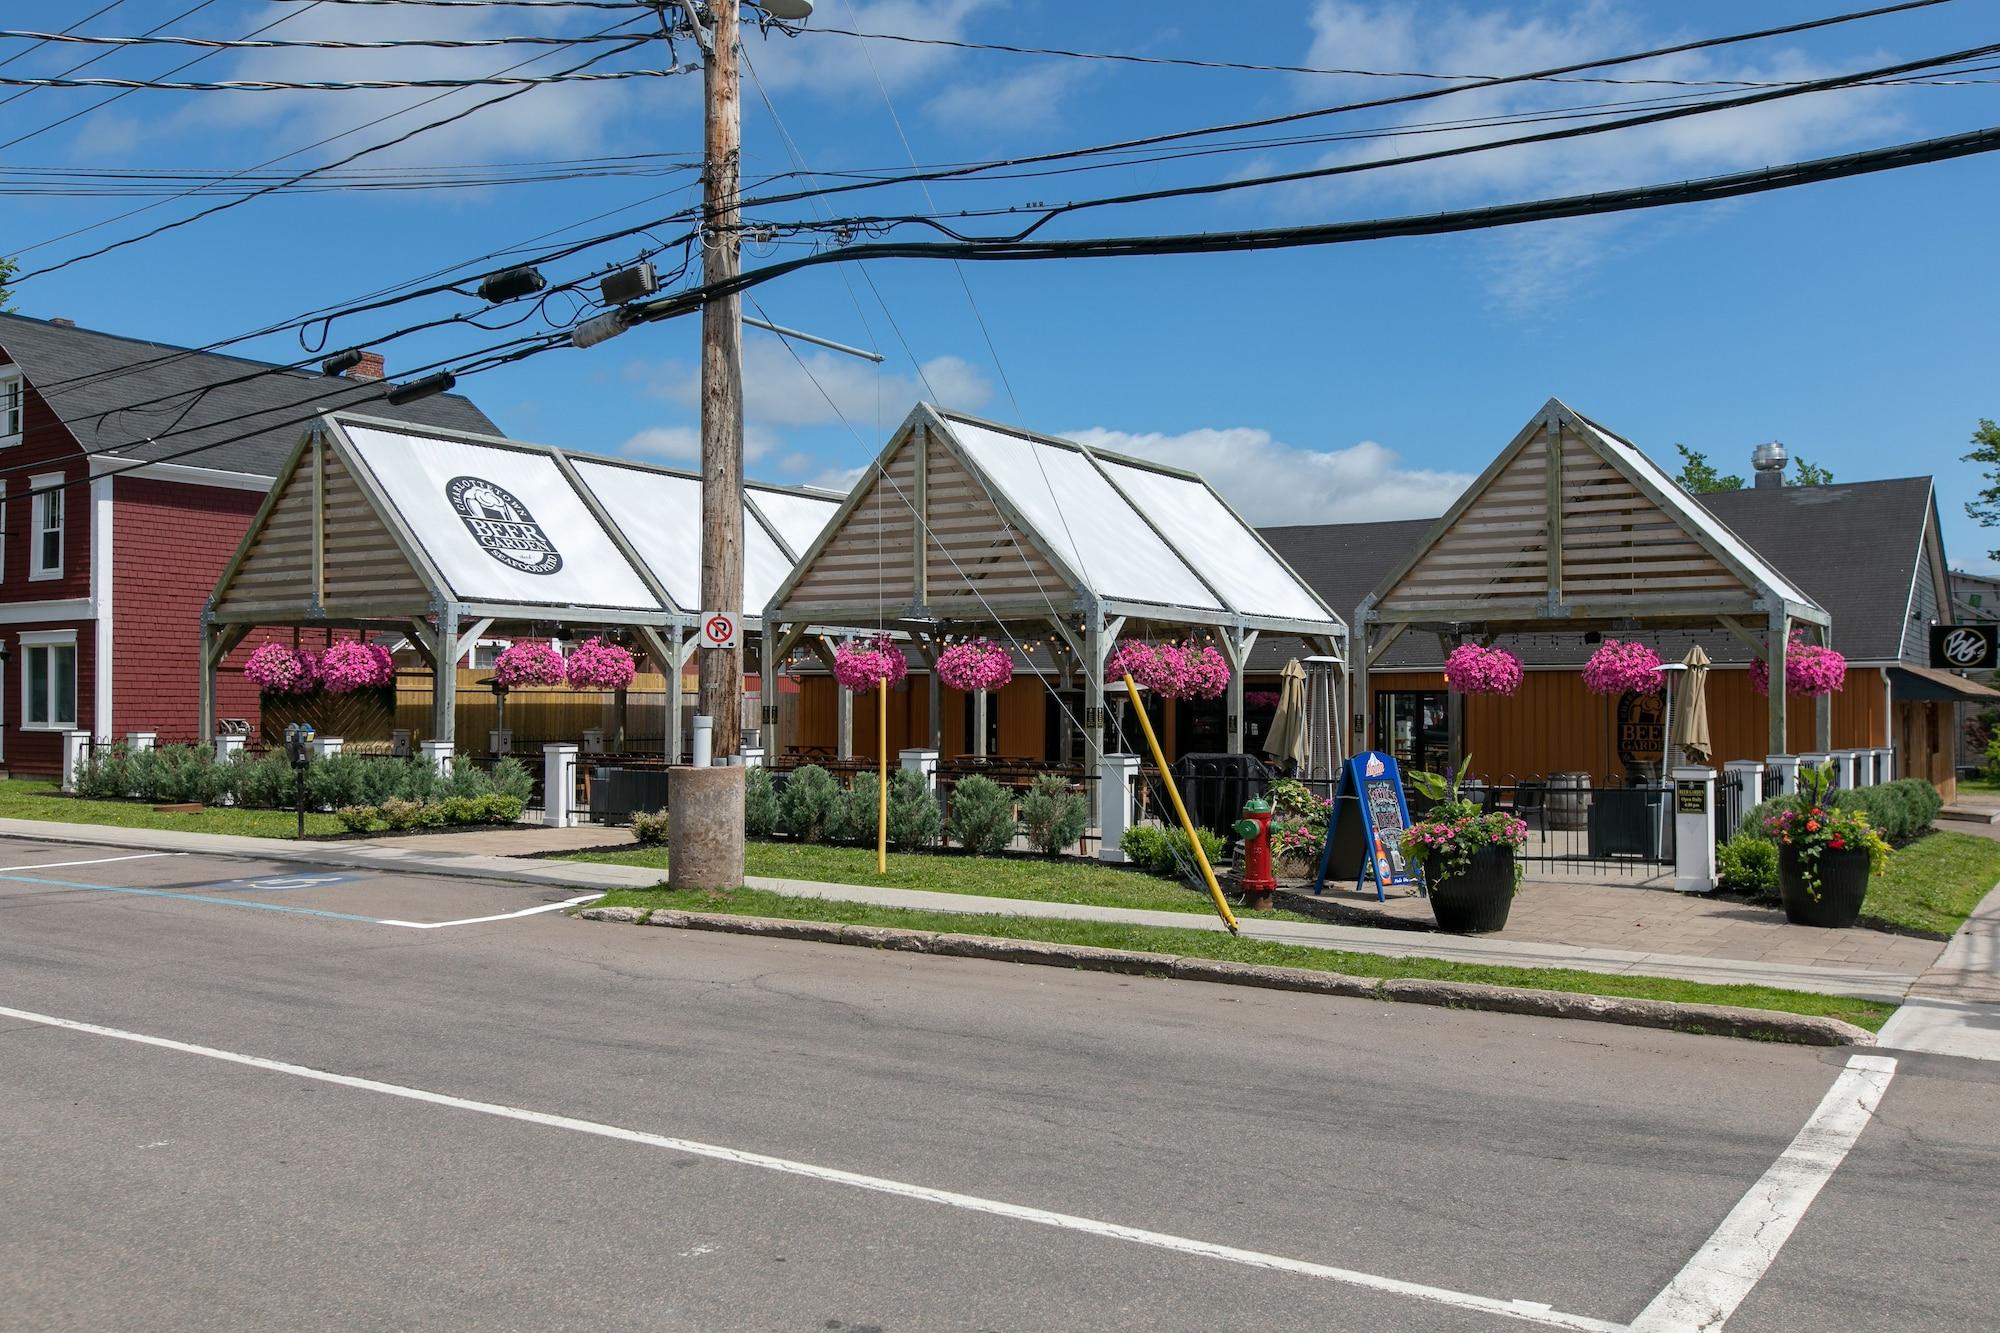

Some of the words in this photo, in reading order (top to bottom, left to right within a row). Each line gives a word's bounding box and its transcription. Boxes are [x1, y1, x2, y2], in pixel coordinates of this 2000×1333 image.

[467, 518, 547, 542] BEER
[480, 535, 552, 553] GARDEN
[490, 549, 543, 573] SEAFOOD
[1623, 724, 1665, 740] BEE
[1622, 739, 1665, 751] GARDE
